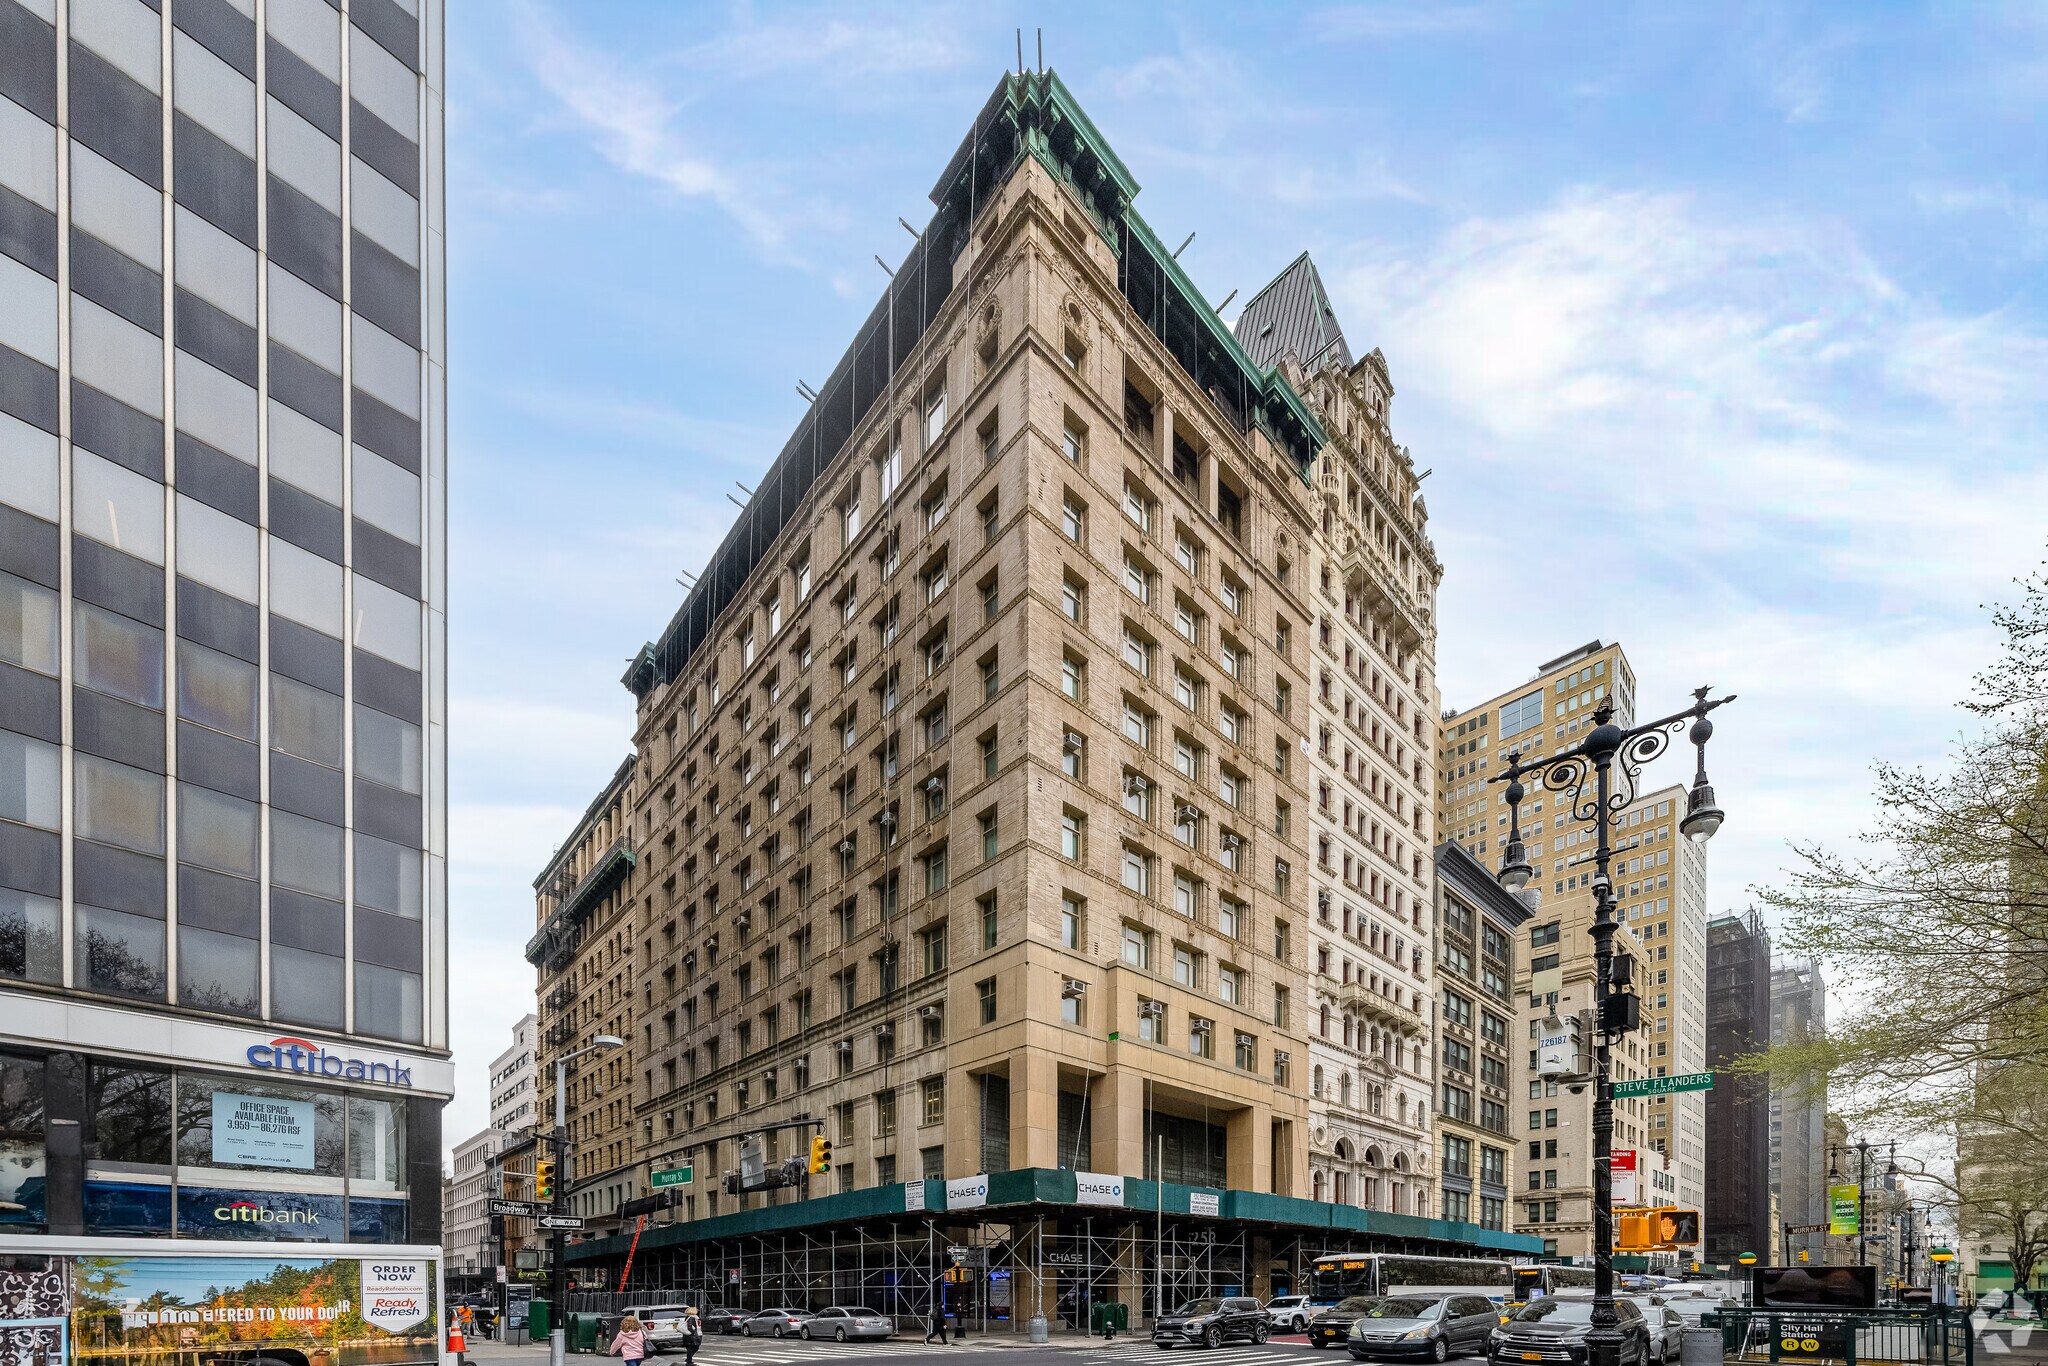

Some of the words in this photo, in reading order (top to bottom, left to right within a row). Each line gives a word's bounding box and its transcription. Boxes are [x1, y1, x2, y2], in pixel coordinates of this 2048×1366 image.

[1540, 1036, 1567, 1048] 726187
[246, 1042, 412, 1086] citibank
[1615, 1081, 1649, 1093] STEVE
[1654, 1074, 1711, 1088] FLANDERS
[1647, 1086, 1677, 1094] SQUARE
[240, 1101, 265, 1113] OFFICE
[266, 1104, 289, 1115] SPACE
[234, 1111, 272, 1123] AVAILABLE
[273, 1115, 295, 1125] FROM
[227, 1120, 250, 1130] 3,959
[260, 1123, 287, 1134] 86,276
[288, 1126, 301, 1135] RSF
[661, 1174, 677, 1184] Murray
[677, 1171, 683, 1181] St
[949, 1187, 976, 1198] CHASE
[1078, 1184, 1111, 1194] CHASE
[214, 1204, 320, 1224] citibank
[493, 1203, 530, 1214] Broadway
[1792, 1226, 1818, 1234] MURRAY
[1819, 1224, 1828, 1232] ST
[1049, 1253, 1083, 1263] CHASE
[372, 1265, 416, 1273] ORDER
[377, 1273, 412, 1281] NOW
[375, 1297, 417, 1308] Ready
[257, 1307, 275, 1321] TO
[279, 1306, 315, 1321] YOUR
[370, 1306, 420, 1316] Refresh
[1780, 1324, 1801, 1333] City
[1780, 1331, 1817, 1339] Station
[1804, 1341, 1816, 1349] W
